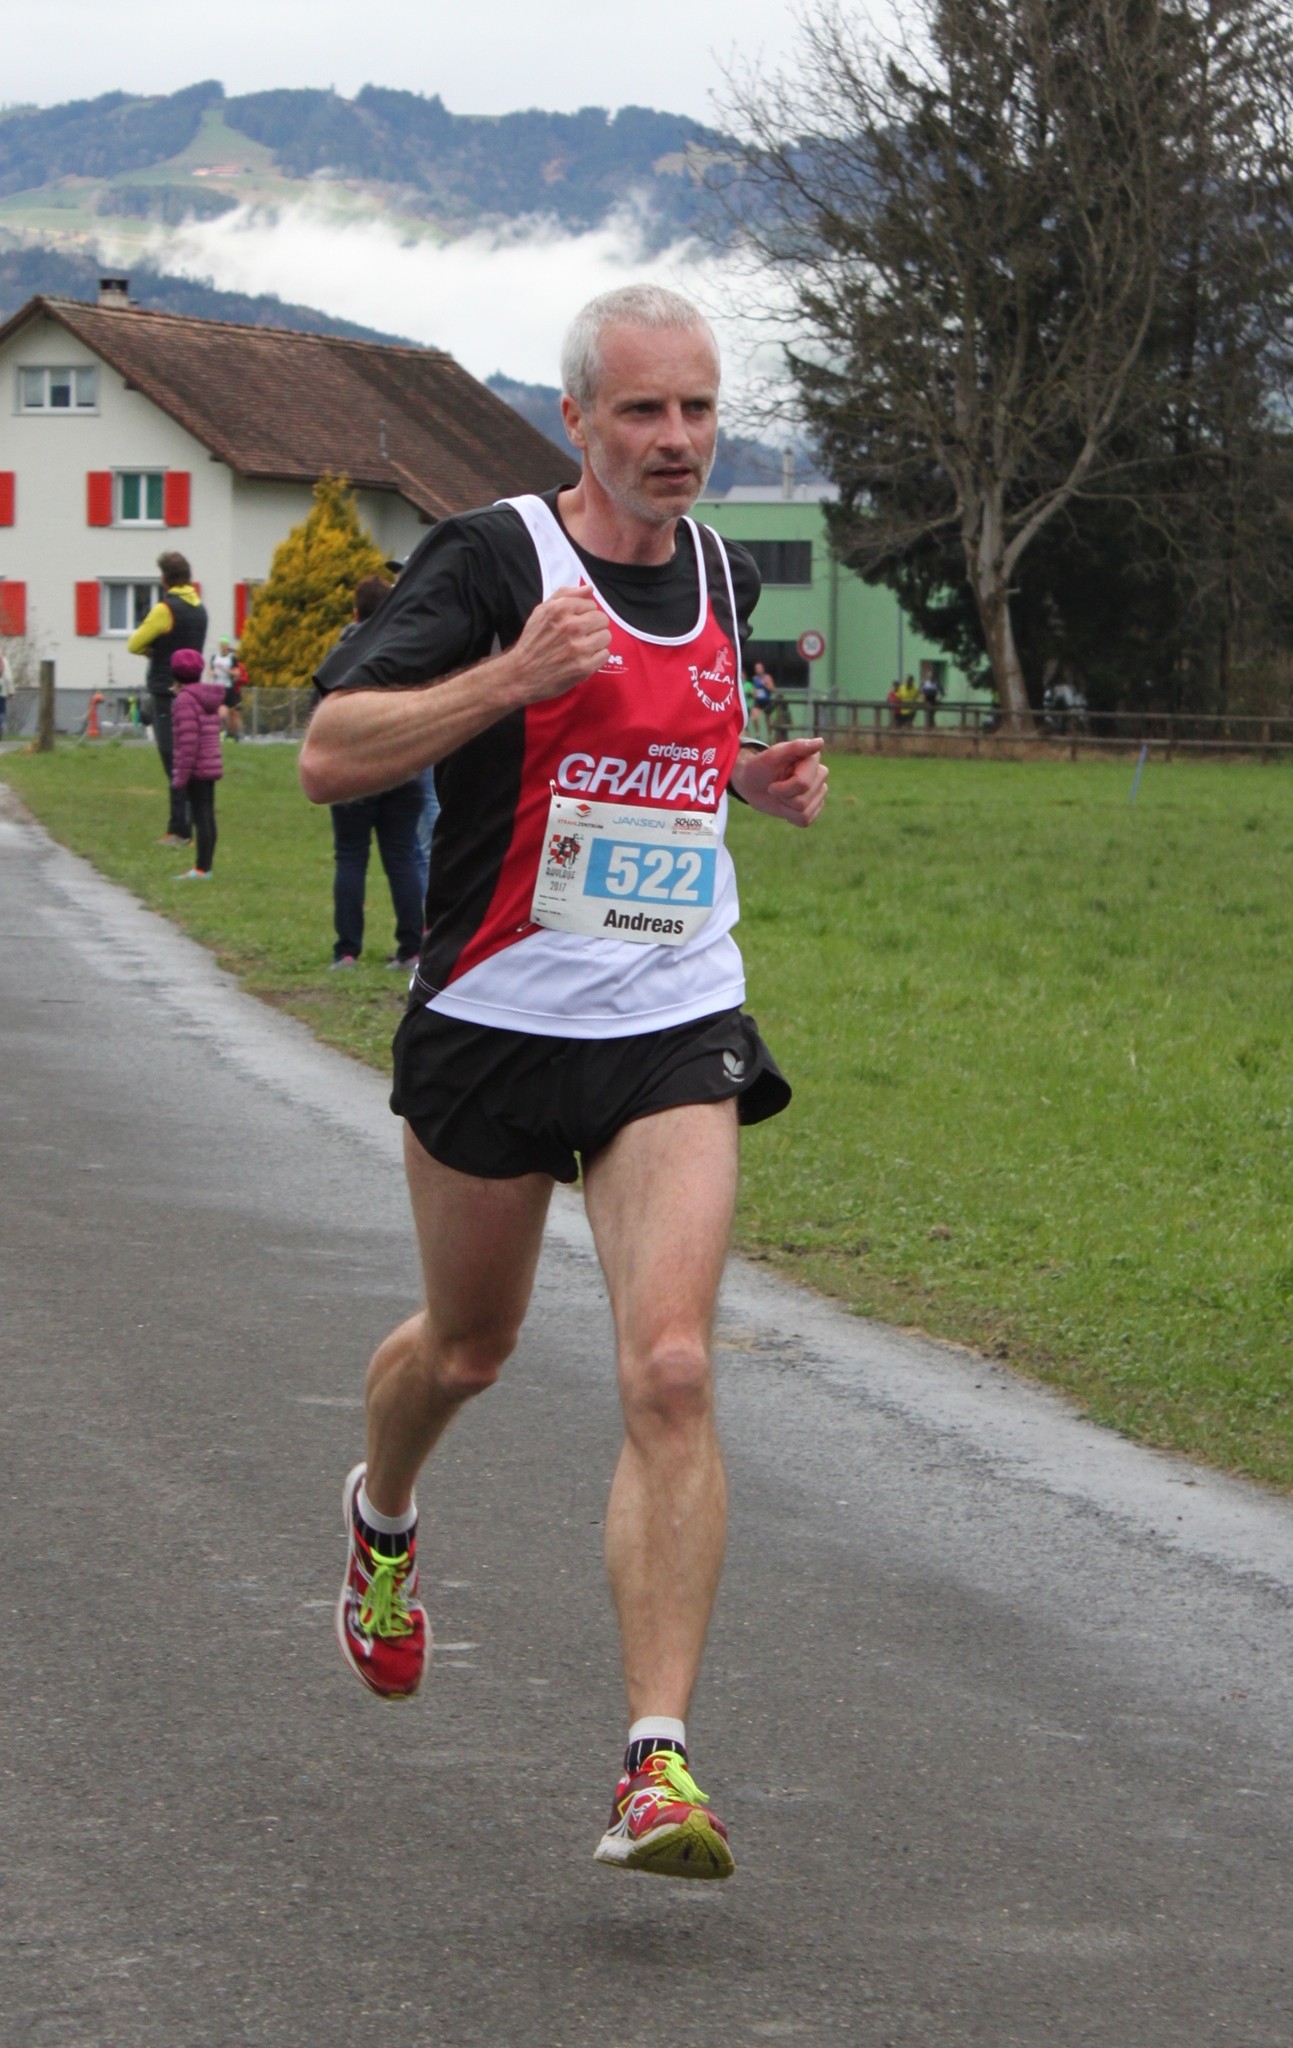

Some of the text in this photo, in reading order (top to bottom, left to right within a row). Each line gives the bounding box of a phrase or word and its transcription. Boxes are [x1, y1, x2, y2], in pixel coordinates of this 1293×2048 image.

[648, 742, 699, 762] erdgas
[557, 751, 719, 806] GRAVAG
[612, 815, 666, 830] JANSEN
[605, 845, 702, 902] 522
[549, 881, 567, 893] 2017
[603, 908, 684, 935] Andreas
